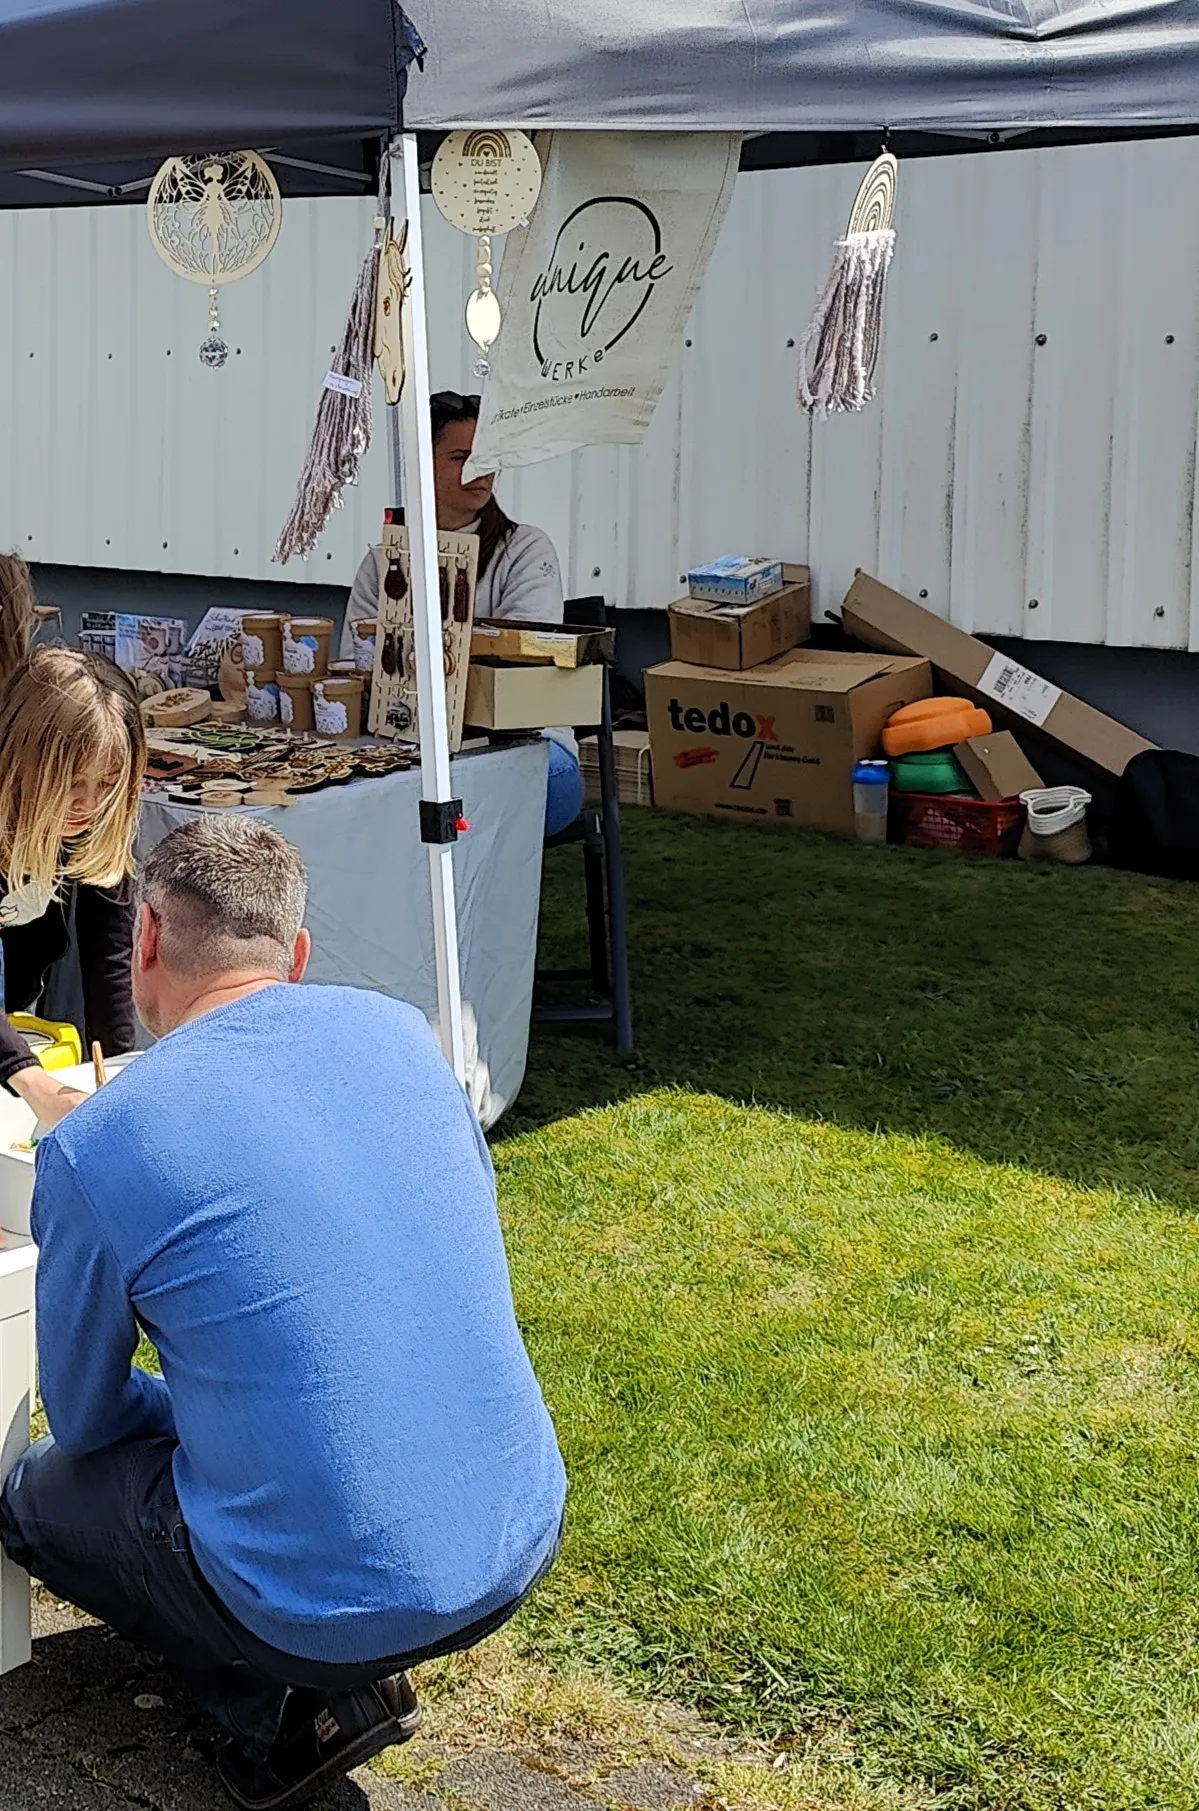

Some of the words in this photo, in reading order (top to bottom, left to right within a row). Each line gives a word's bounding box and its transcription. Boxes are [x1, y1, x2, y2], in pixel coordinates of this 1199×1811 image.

[471, 159, 483, 167] DU
[530, 242, 673, 338] unique
[579, 386, 636, 401] Handarbeit
[667, 698, 779, 742] tedox
